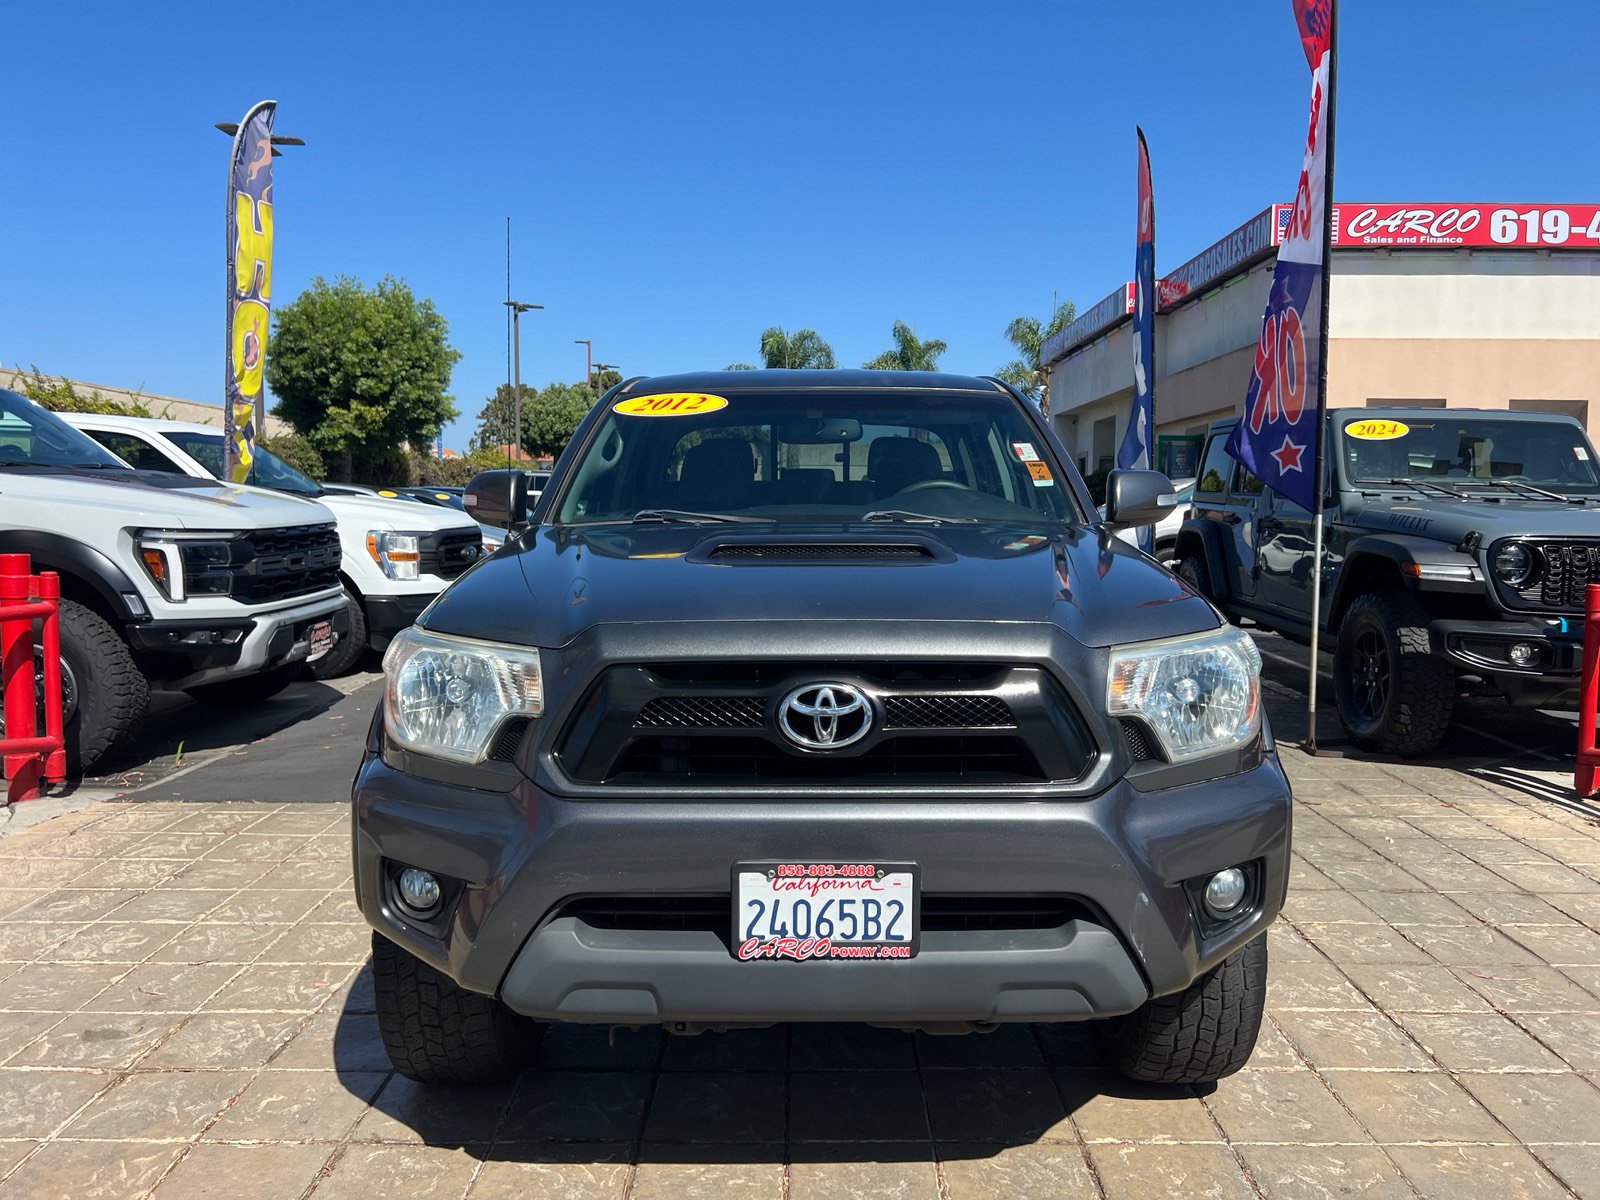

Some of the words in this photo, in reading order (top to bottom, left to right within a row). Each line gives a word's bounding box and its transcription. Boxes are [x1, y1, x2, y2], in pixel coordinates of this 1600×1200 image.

[1347, 208, 1481, 237] CARCO
[1363, 235, 1394, 244] Sales
[1396, 235, 1417, 244] and
[1419, 235, 1463, 244] Finance
[1188, 212, 1271, 290] CARCOSALES.COM
[632, 396, 708, 412] 2012
[1357, 423, 1398, 436] 2024
[777, 864, 875, 877] 858-883-4888
[772, 877, 885, 897] California
[745, 898, 905, 941] 24065B2
[739, 936, 831, 959] CARCO
[831, 945, 911, 958] POWAY.COM
